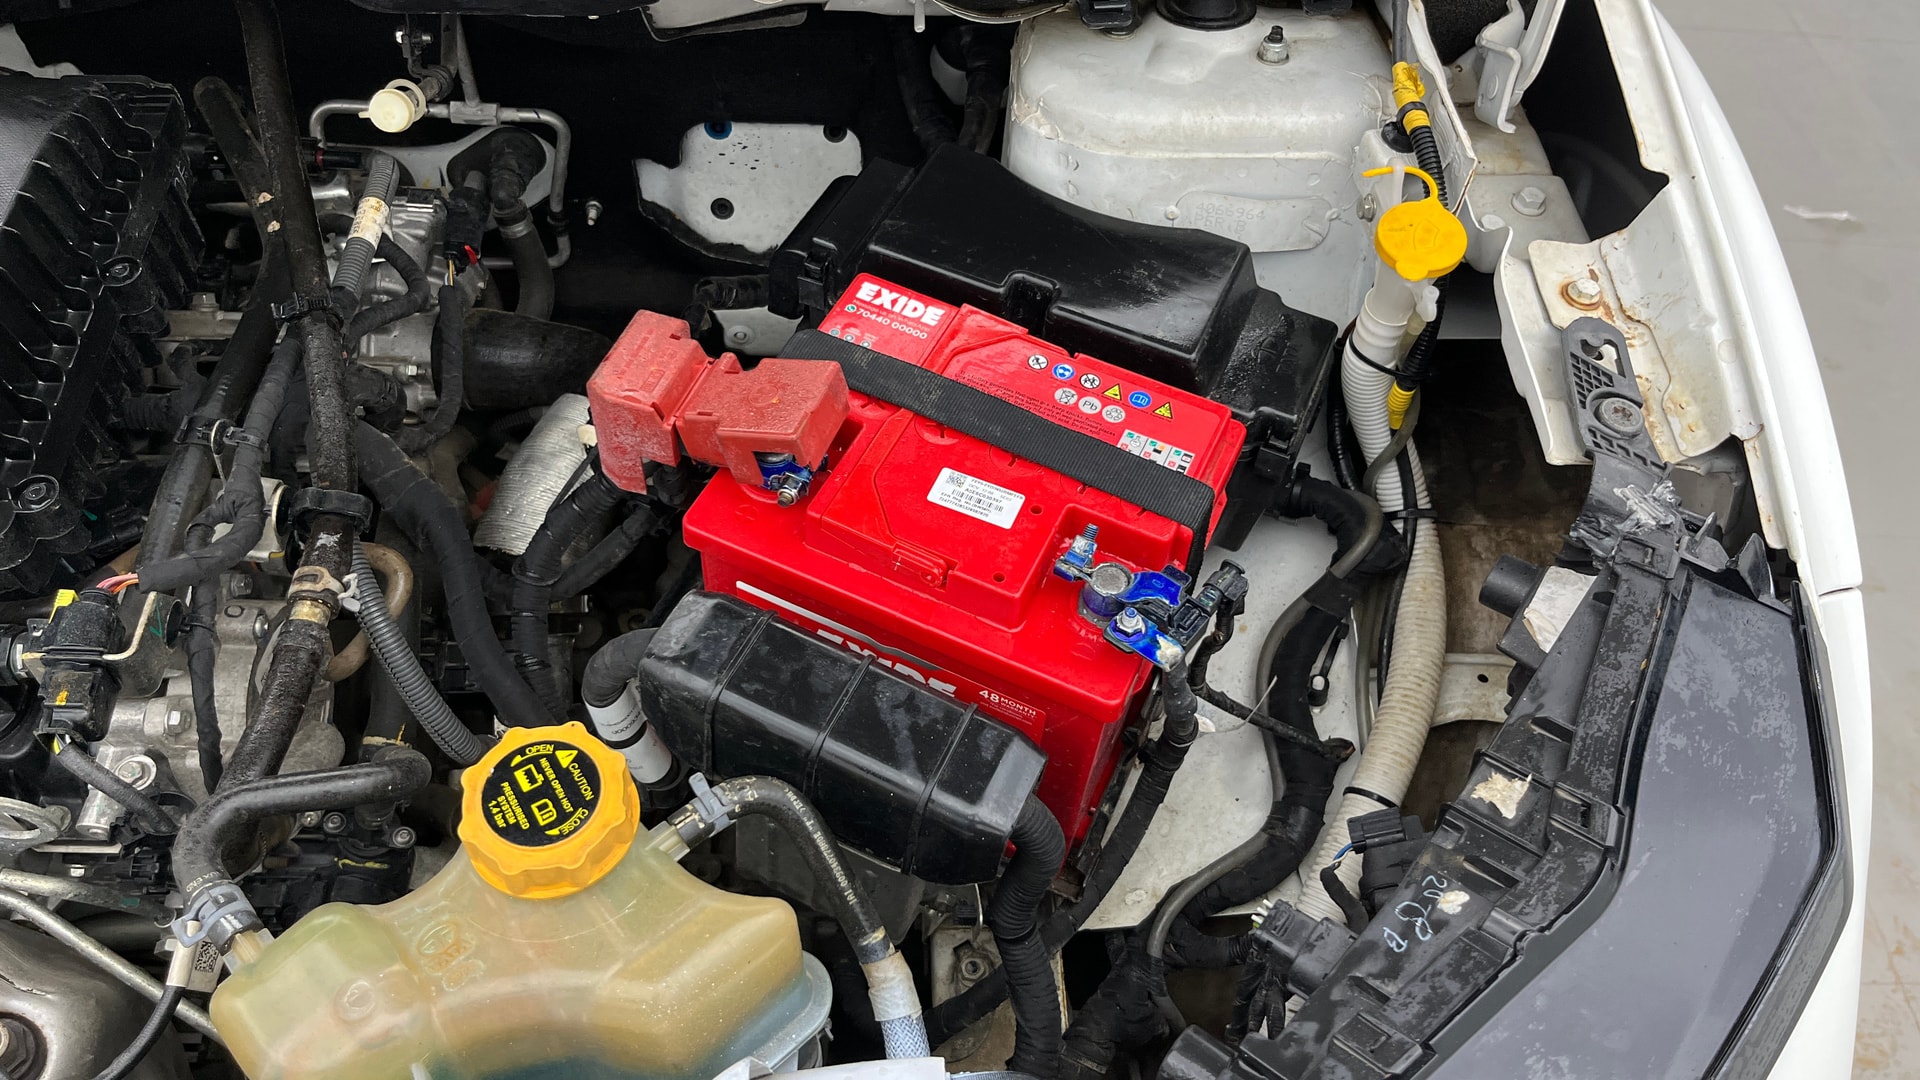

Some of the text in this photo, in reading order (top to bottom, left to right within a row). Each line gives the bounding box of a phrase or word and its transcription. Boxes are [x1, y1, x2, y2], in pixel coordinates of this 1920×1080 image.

[855, 281, 946, 327] EXIDE
[856, 308, 890, 326] 70440
[891, 321, 928, 340] 00000
[1082, 400, 1098, 412] Pb
[978, 689, 1000, 703] 48
[1000, 696, 1037, 716] MONTH
[525, 743, 555, 755] OPEN
[539, 757, 574, 814] NEVER OPEN HOT
[569, 762, 595, 801] CAUTION
[488, 800, 507, 829] 1.4 bar
[497, 795, 518, 825] SYSTEM
[500, 781, 531, 831] PRESSURISED
[561, 807, 589, 836] CLOSE
